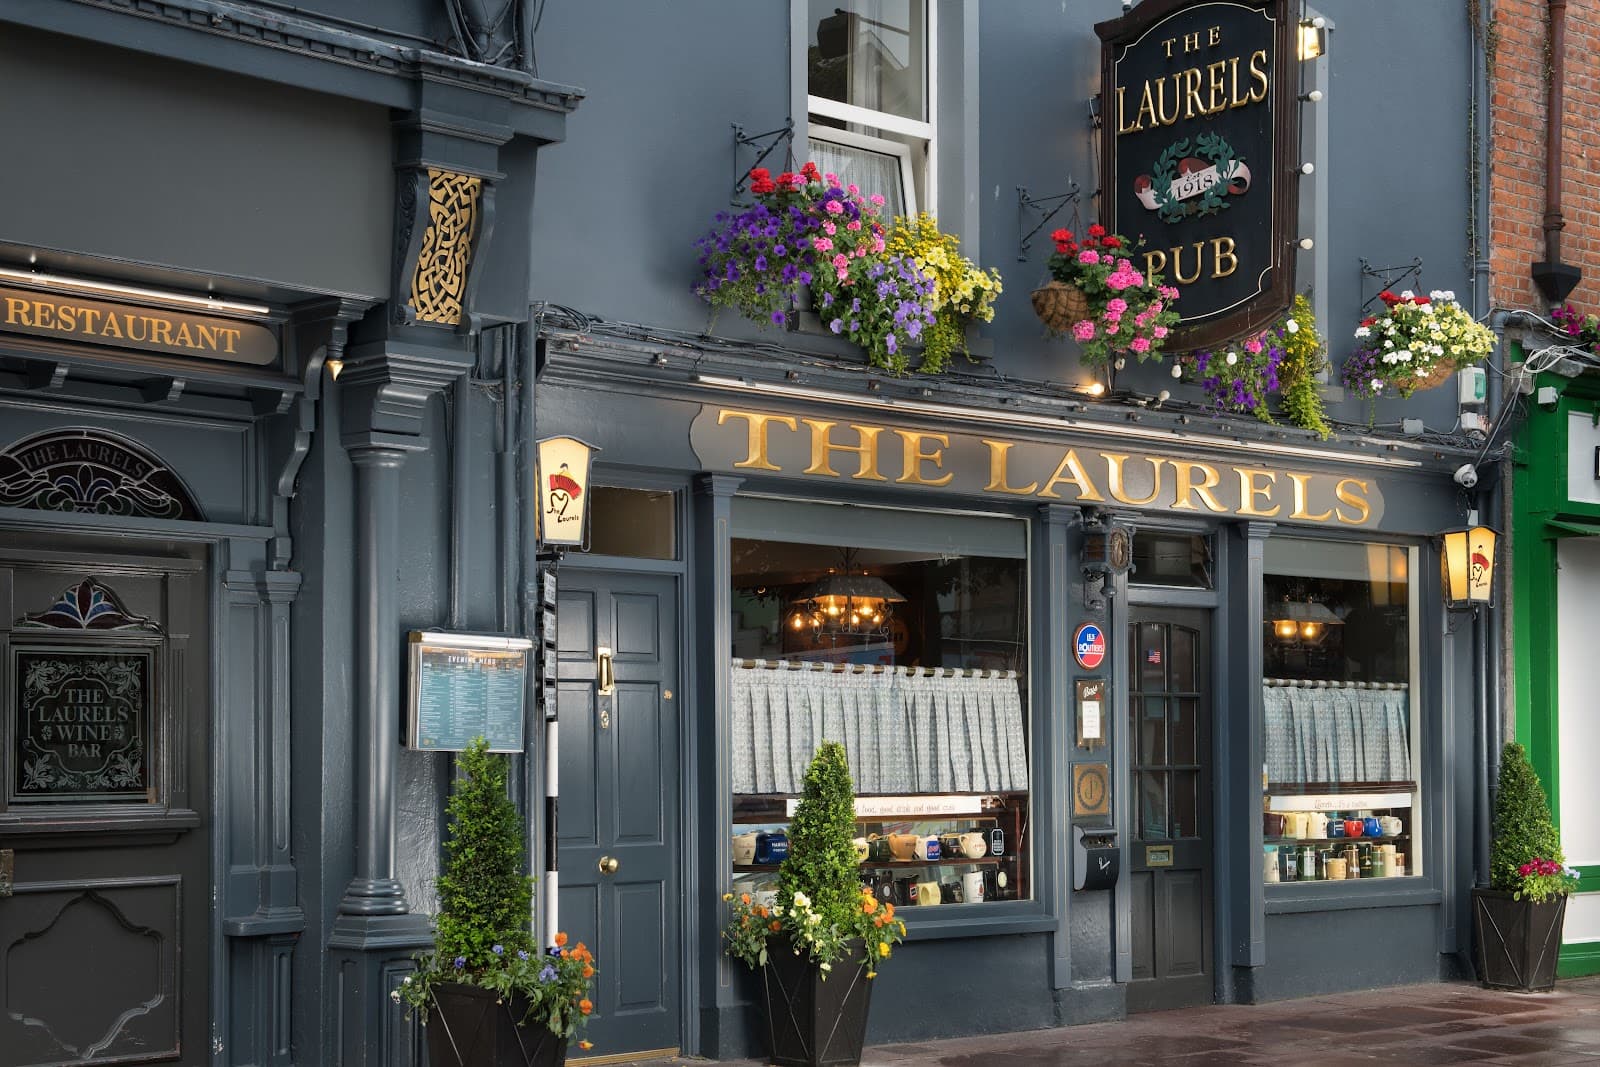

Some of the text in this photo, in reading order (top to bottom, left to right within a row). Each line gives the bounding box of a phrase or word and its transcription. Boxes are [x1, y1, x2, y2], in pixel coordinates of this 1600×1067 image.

[1162, 25, 1222, 58] THE
[1116, 49, 1269, 135] LAURELS
[1176, 174, 1213, 198] 1918
[1142, 236, 1239, 287] PUB
[4, 297, 241, 354] RESTAURANT
[21, 443, 146, 478] THE LAURELS
[717, 409, 1371, 526] THE LAURELS
[557, 514, 579, 523] Laurels
[1079, 643, 1105, 653] ROUTIERS
[65, 688, 104, 704] THE
[38, 705, 129, 722] LAURELS
[56, 725, 112, 741] WINE
[68, 743, 101, 758] BAR
